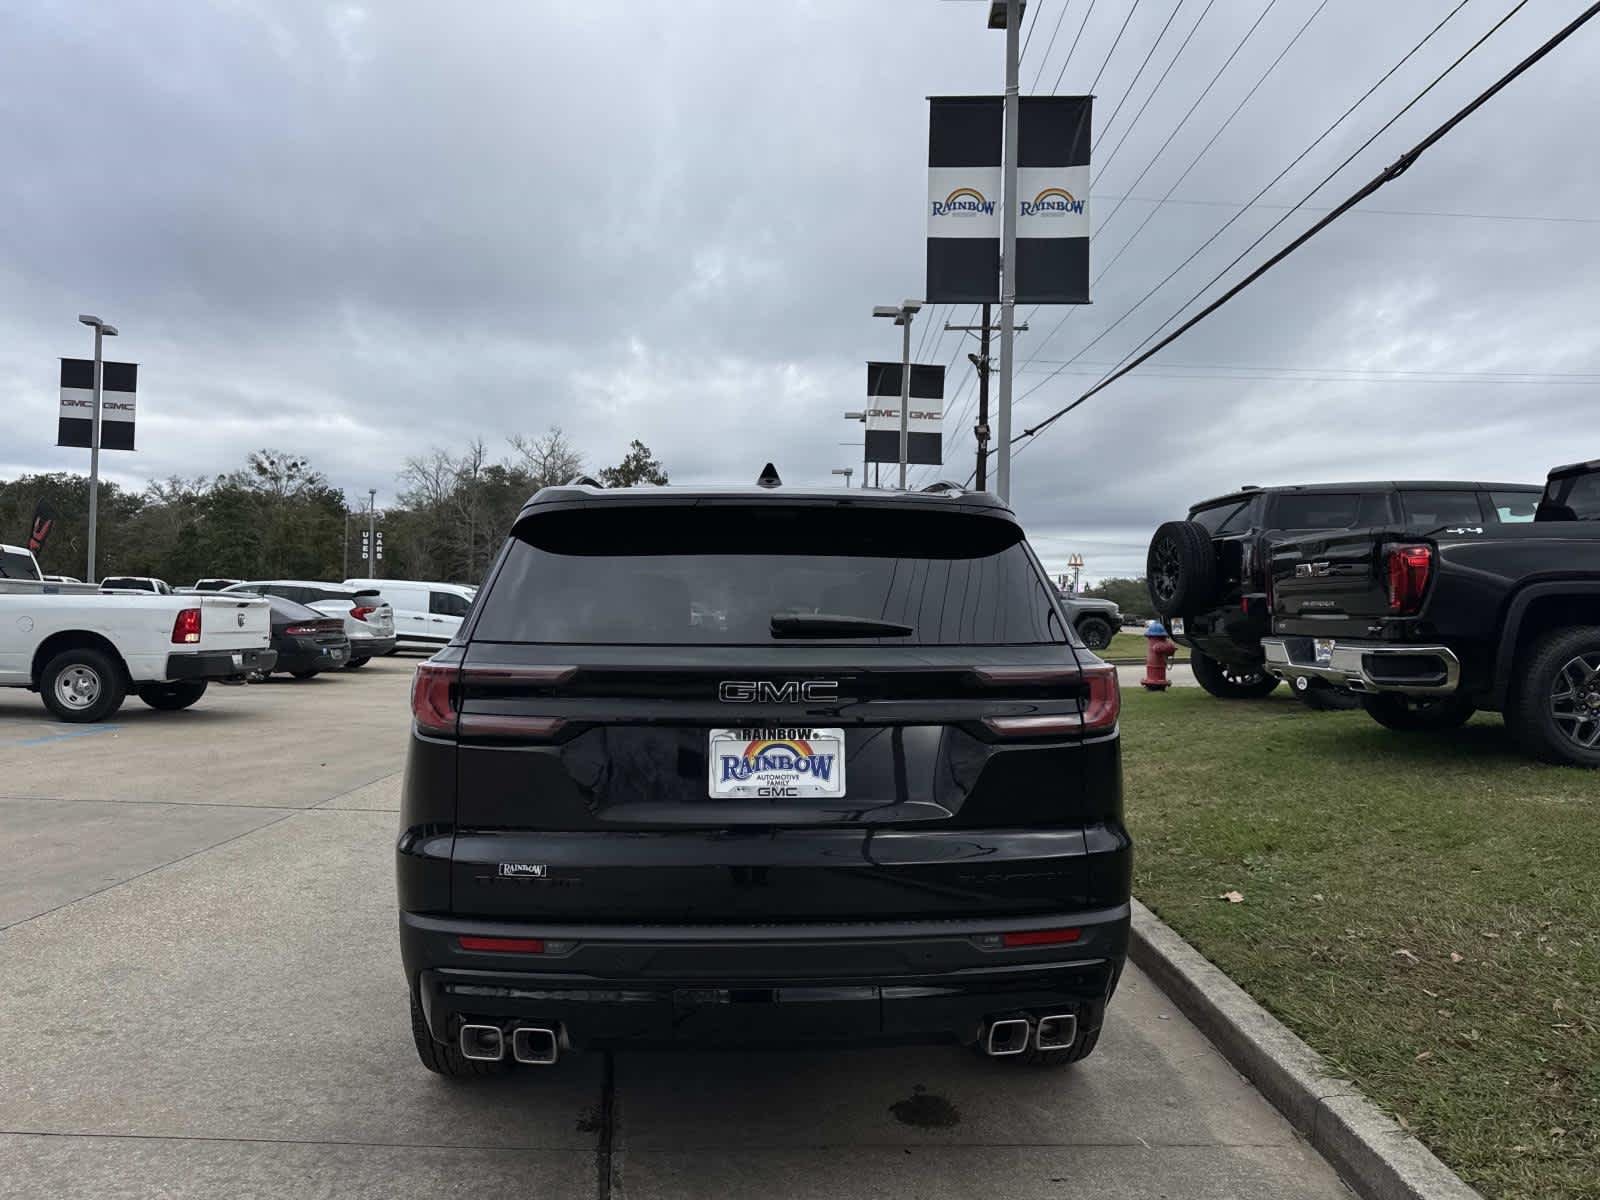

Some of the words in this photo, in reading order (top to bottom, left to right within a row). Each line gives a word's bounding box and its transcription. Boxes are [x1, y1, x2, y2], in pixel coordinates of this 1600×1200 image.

[932, 200, 997, 216] RAINBOW
[1020, 200, 1085, 216] RAINBOW
[61, 399, 95, 408] GMC
[103, 402, 136, 411] GMC
[868, 409, 900, 418] GMC
[910, 411, 944, 420] GMC
[719, 680, 838, 703] GMC
[742, 728, 812, 741] RAINBOW
[719, 753, 835, 784] RAINBOW
[757, 787, 798, 797] GMC
[503, 863, 542, 877] RAINBOW
